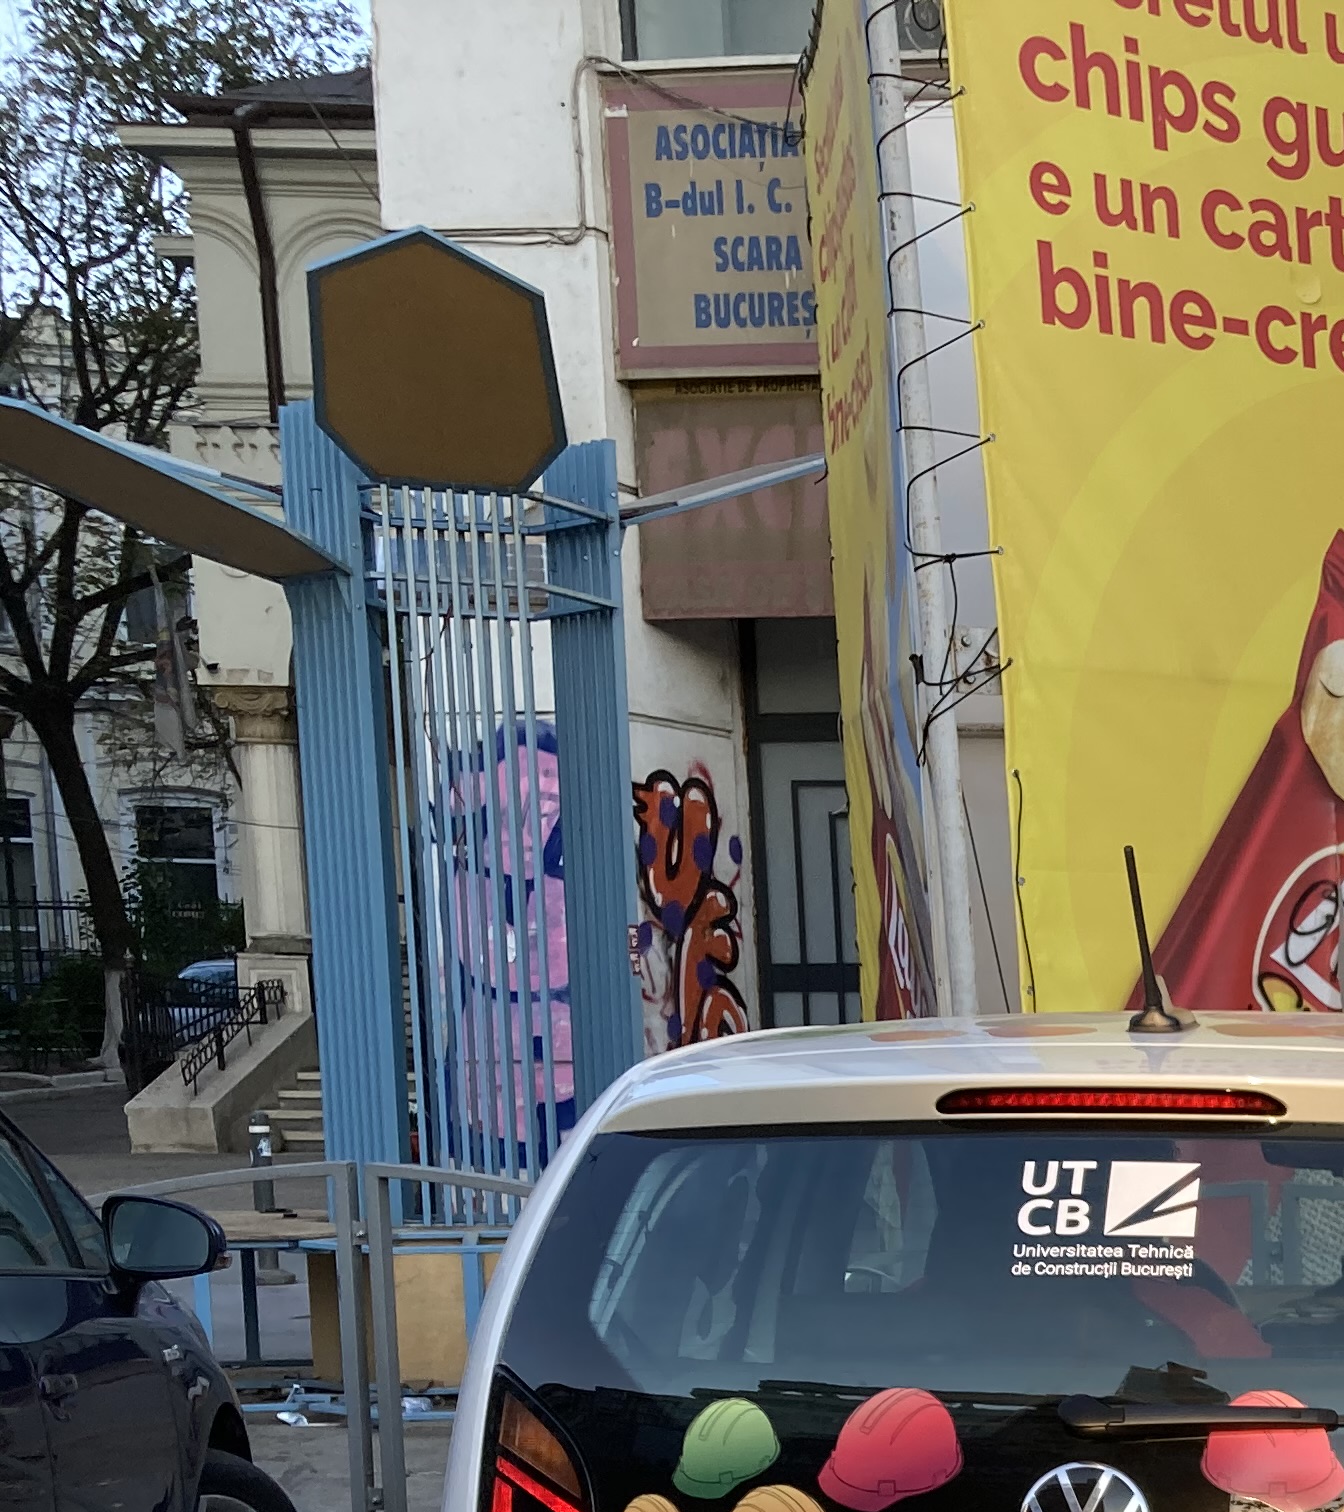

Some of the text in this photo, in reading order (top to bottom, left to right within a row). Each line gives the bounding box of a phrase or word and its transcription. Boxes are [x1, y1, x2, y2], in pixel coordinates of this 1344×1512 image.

[1018, 21, 1240, 152] chips
[645, 177, 792, 218] B-dul I. C.
[1029, 161, 1072, 215] e
[1093, 172, 1180, 239] un
[714, 235, 802, 272] SCARA
[1021, 1160, 1098, 1196] UT
[1017, 1198, 1091, 1236] CB
[1011, 1261, 1031, 1275] de
[1013, 1243, 1194, 1259] Universitatea Tehnică
